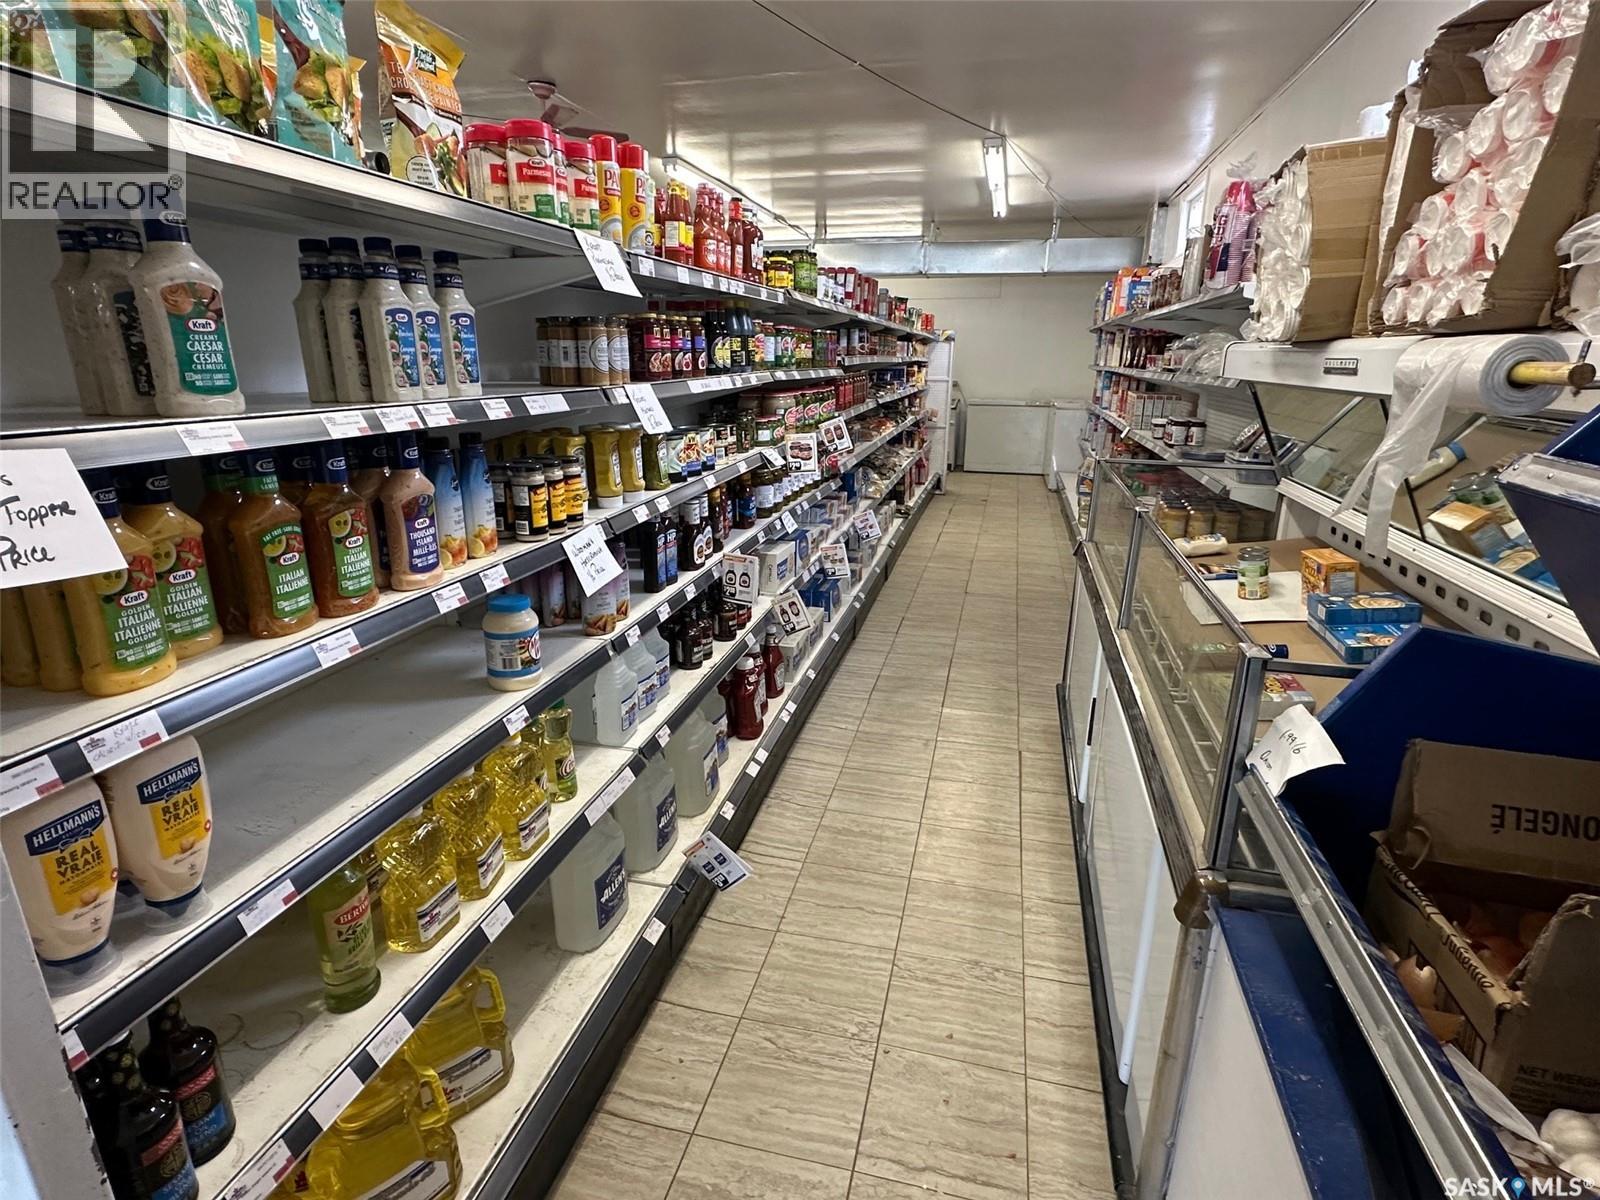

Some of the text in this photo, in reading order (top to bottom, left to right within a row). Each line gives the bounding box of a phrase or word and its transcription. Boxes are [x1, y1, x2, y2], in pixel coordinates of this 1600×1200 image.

[192, 320, 213, 330] Kraft
[186, 340, 224, 352] CAESAR
[348, 537, 362, 547] Kraft
[666, 530, 677, 543] HP
[282, 553, 298, 564] Kraft
[344, 550, 368, 564] ITALIAN
[341, 558, 371, 574] ITALIENNE
[172, 570, 194, 582] Kraft
[278, 569, 305, 582] ITALIAN
[170, 582, 198, 593] GOLDEN
[276, 576, 310, 594] ITALIENNE
[123, 592, 146, 605] Kraft
[166, 586, 203, 602] ITALIAN
[121, 604, 151, 618] GOLDEN
[163, 595, 209, 616] ITALIENNE
[176, 607, 204, 619] GOLDEN
[118, 608, 156, 629] ITALIAN
[114, 618, 162, 642] ITALIENNE
[127, 630, 157, 646] GOLDEN
[143, 762, 198, 797] HELLMANN'S
[162, 794, 196, 816] REAL
[162, 802, 199, 825] VRAIE
[32, 804, 101, 848] HELLMANN'S
[1490, 803, 1600, 842] ONGELÉ
[56, 842, 100, 868] REAL
[56, 852, 104, 878] VRAIE
